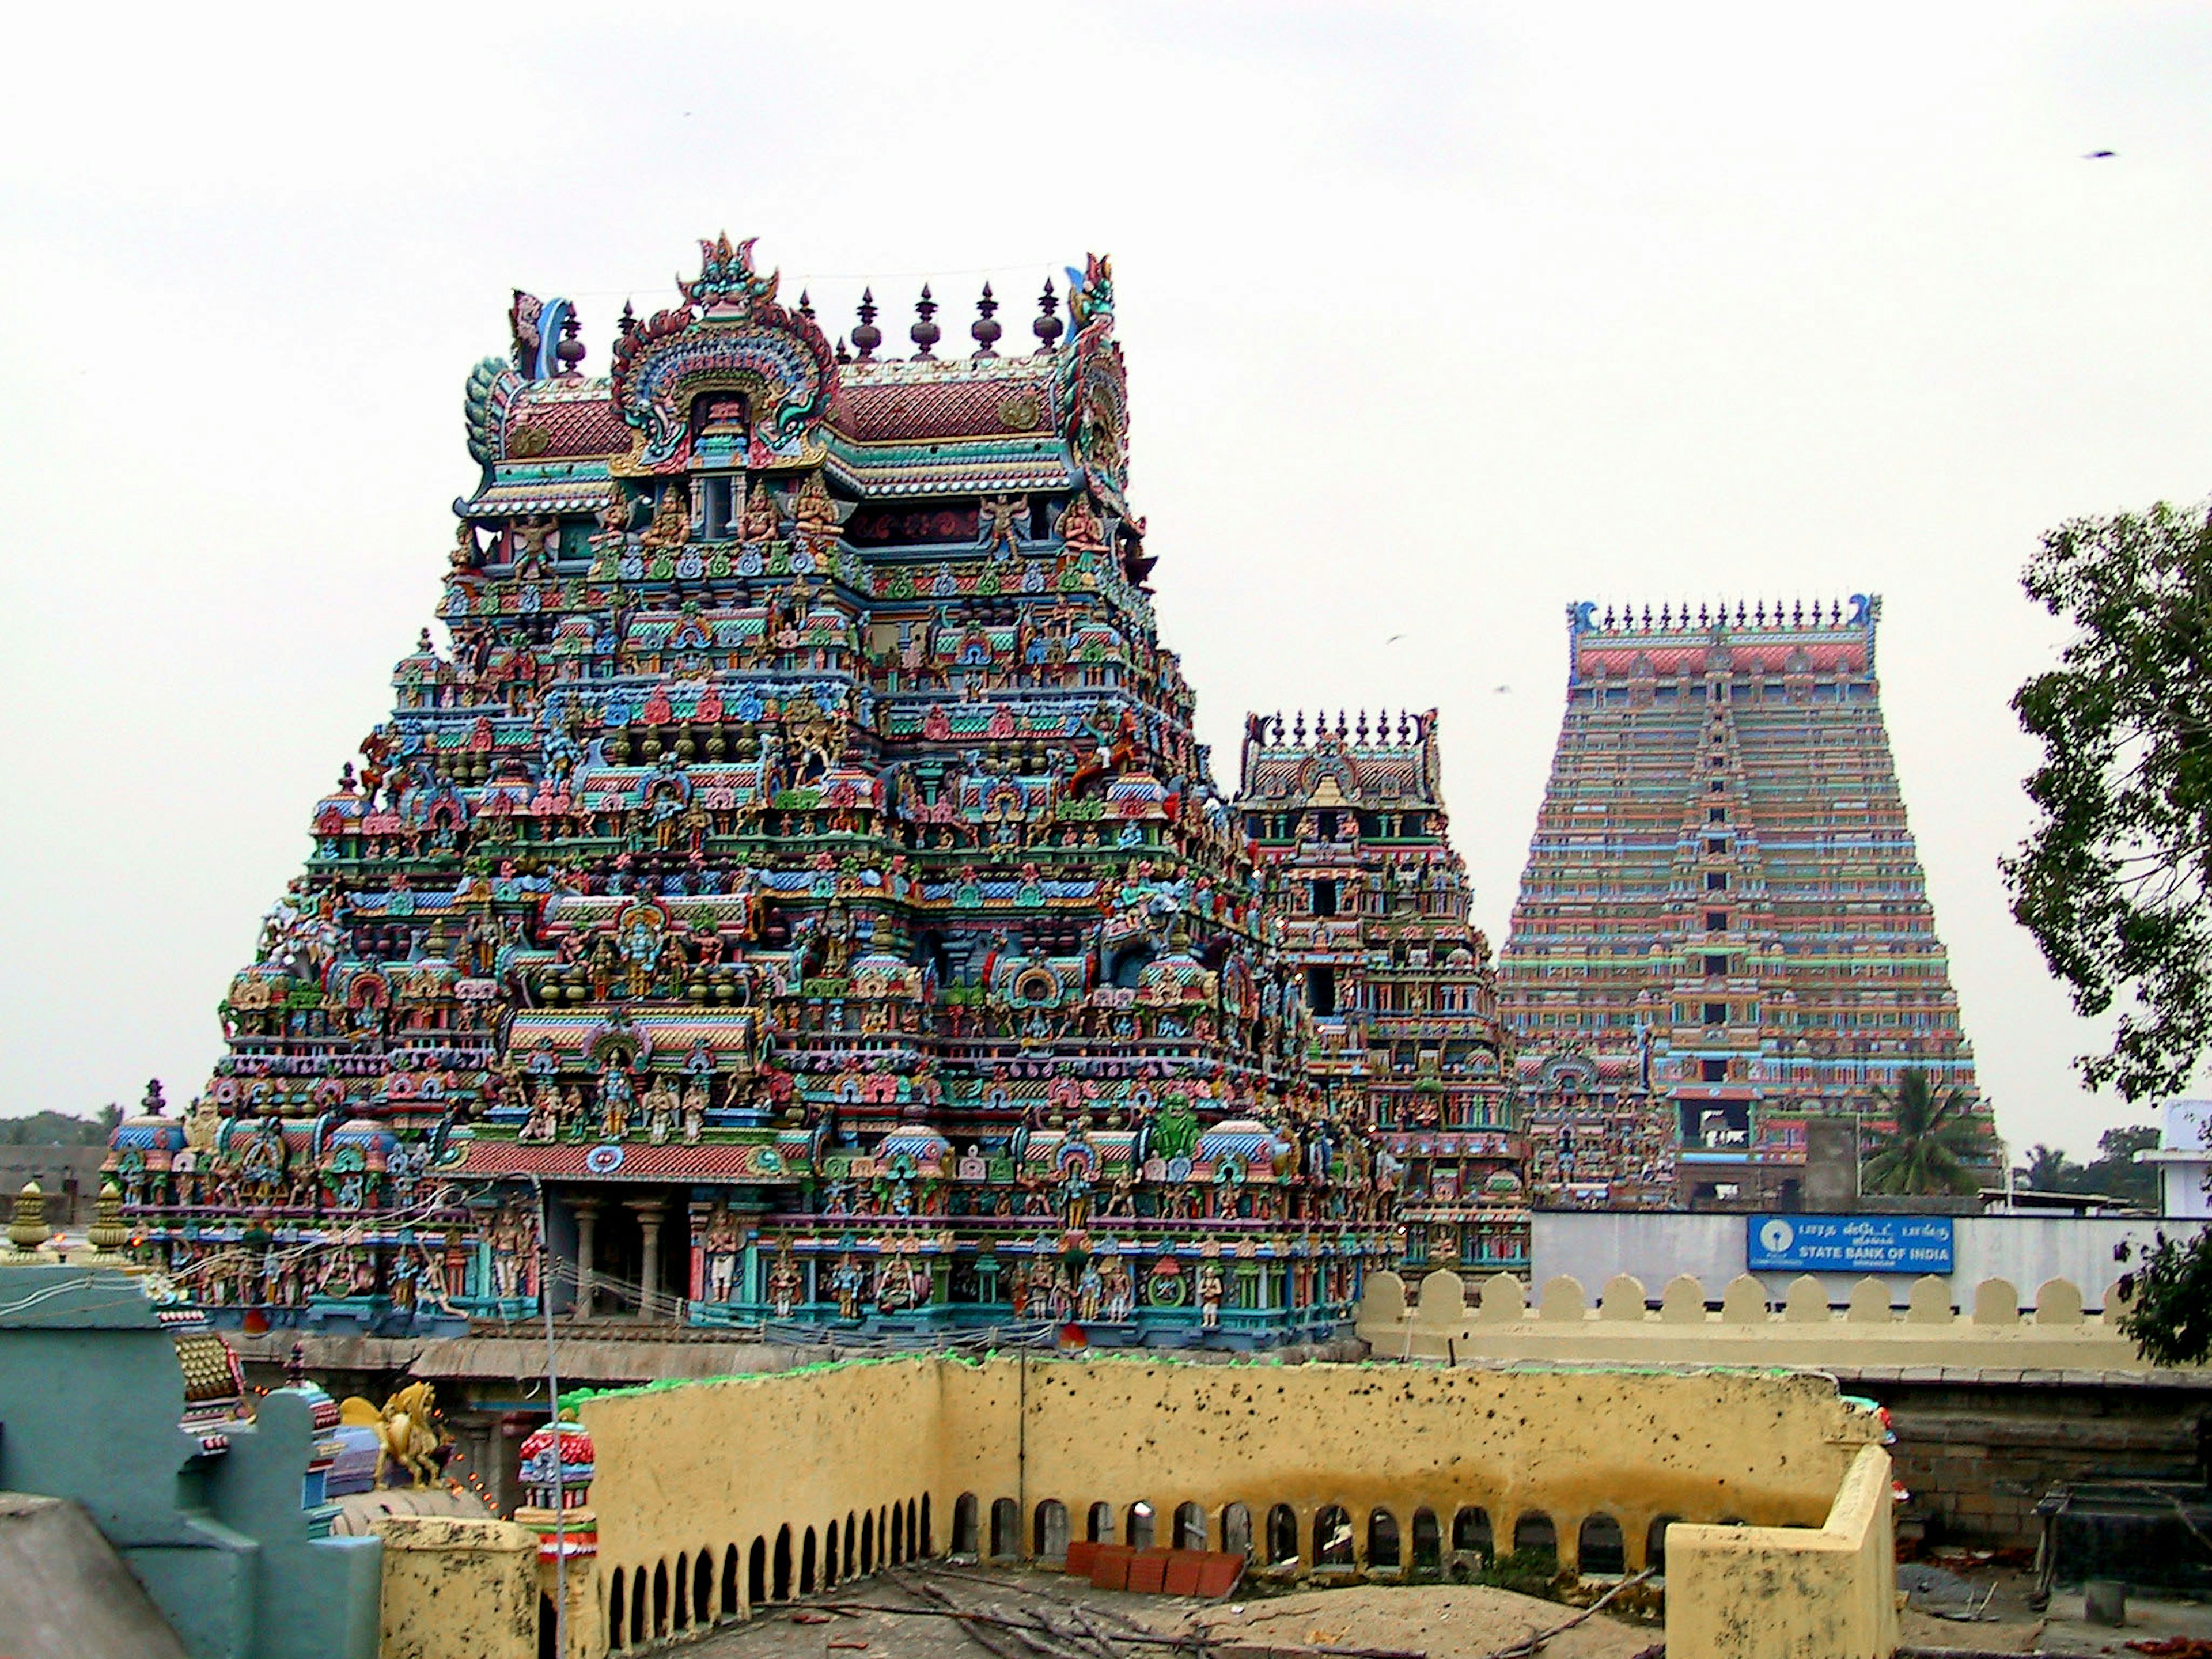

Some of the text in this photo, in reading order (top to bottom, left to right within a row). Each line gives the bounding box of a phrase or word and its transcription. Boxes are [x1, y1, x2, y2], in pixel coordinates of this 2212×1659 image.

[1799, 1245, 1843, 1259] STATE
[1845, 1247, 1885, 1260] BANK
[1888, 1247, 1906, 1260] OF
[1910, 1247, 1949, 1260] INDIA
